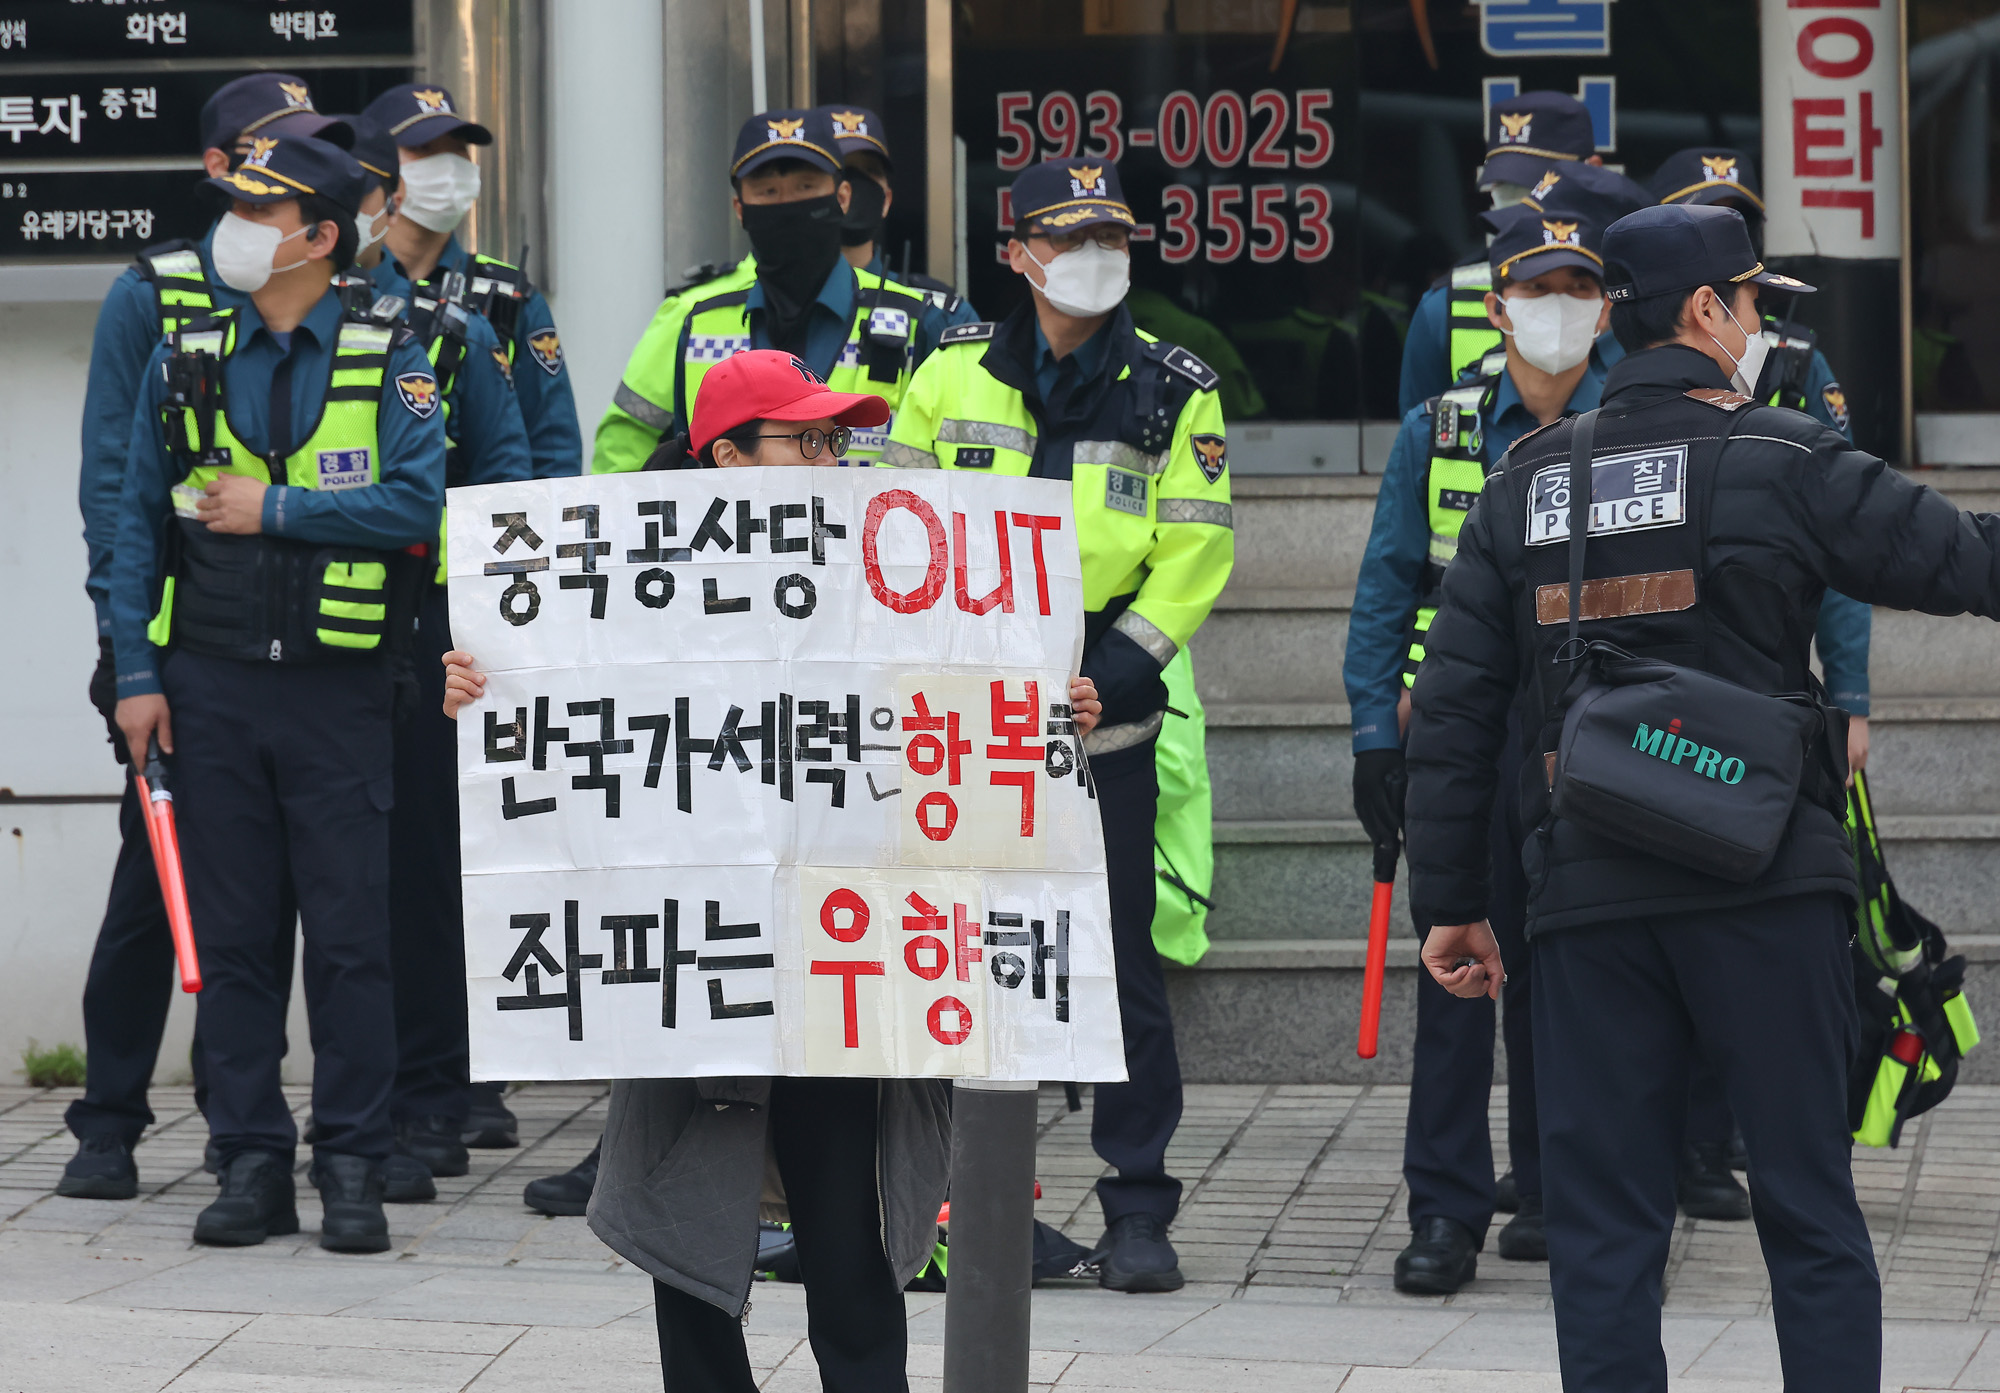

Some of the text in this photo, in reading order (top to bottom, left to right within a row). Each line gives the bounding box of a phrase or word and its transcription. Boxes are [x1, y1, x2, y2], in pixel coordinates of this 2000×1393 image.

[126, 12, 187, 44] 화헌
[270, 11, 339, 41] 박태호
[0, 87, 157, 143] 투자 증권
[996, 89, 1334, 171] 593-0025
[20, 209, 155, 240] 유레카당구장
[324, 474, 366, 486] POLICE
[1545, 497, 1664, 536] PLICE
[483, 488, 1061, 626] 중국공산당 OUT
[1631, 718, 1746, 785] MIPRO
[496, 898, 775, 1042] 좌파는
